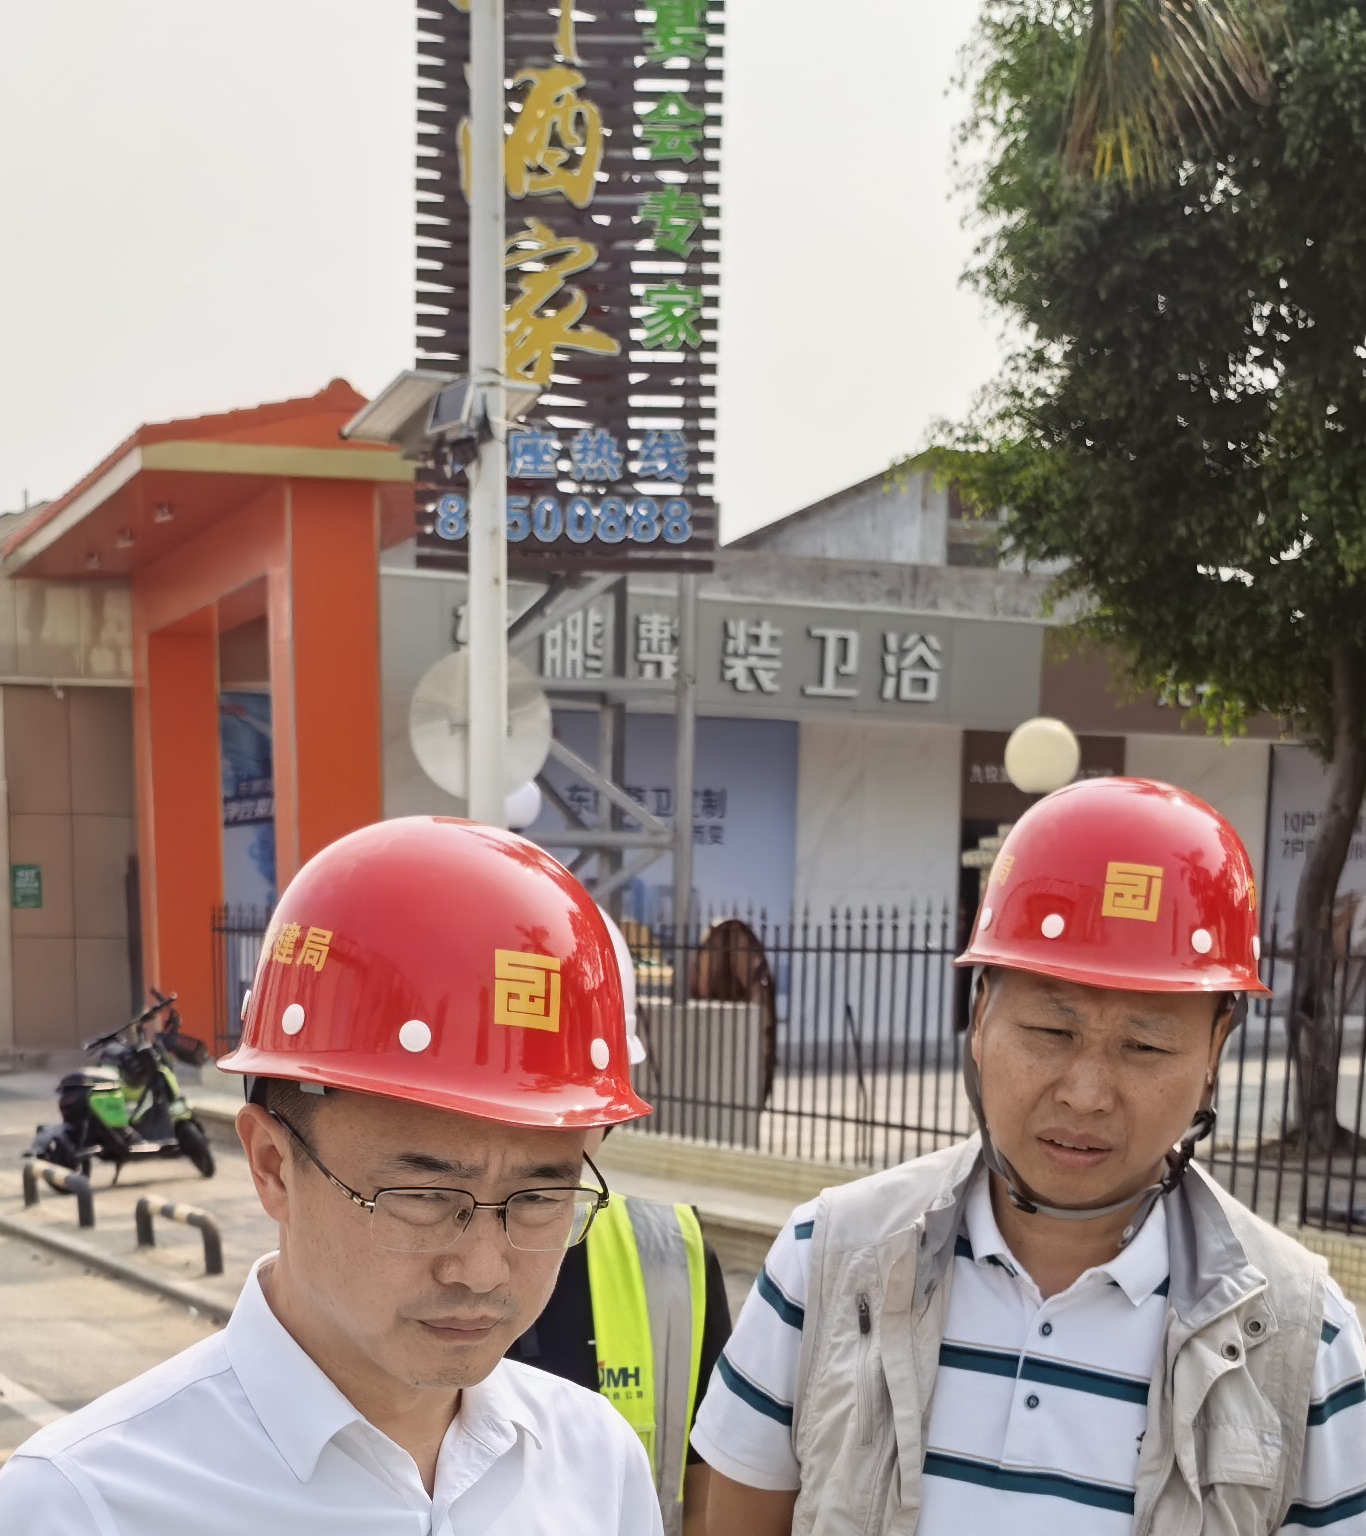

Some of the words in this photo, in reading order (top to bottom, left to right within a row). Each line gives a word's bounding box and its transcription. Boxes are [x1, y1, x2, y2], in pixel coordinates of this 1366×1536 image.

[443, 427, 691, 483] 座热线
[435, 494, 693, 544] 8500888
[454, 603, 942, 702] 鹏整装卫浴
